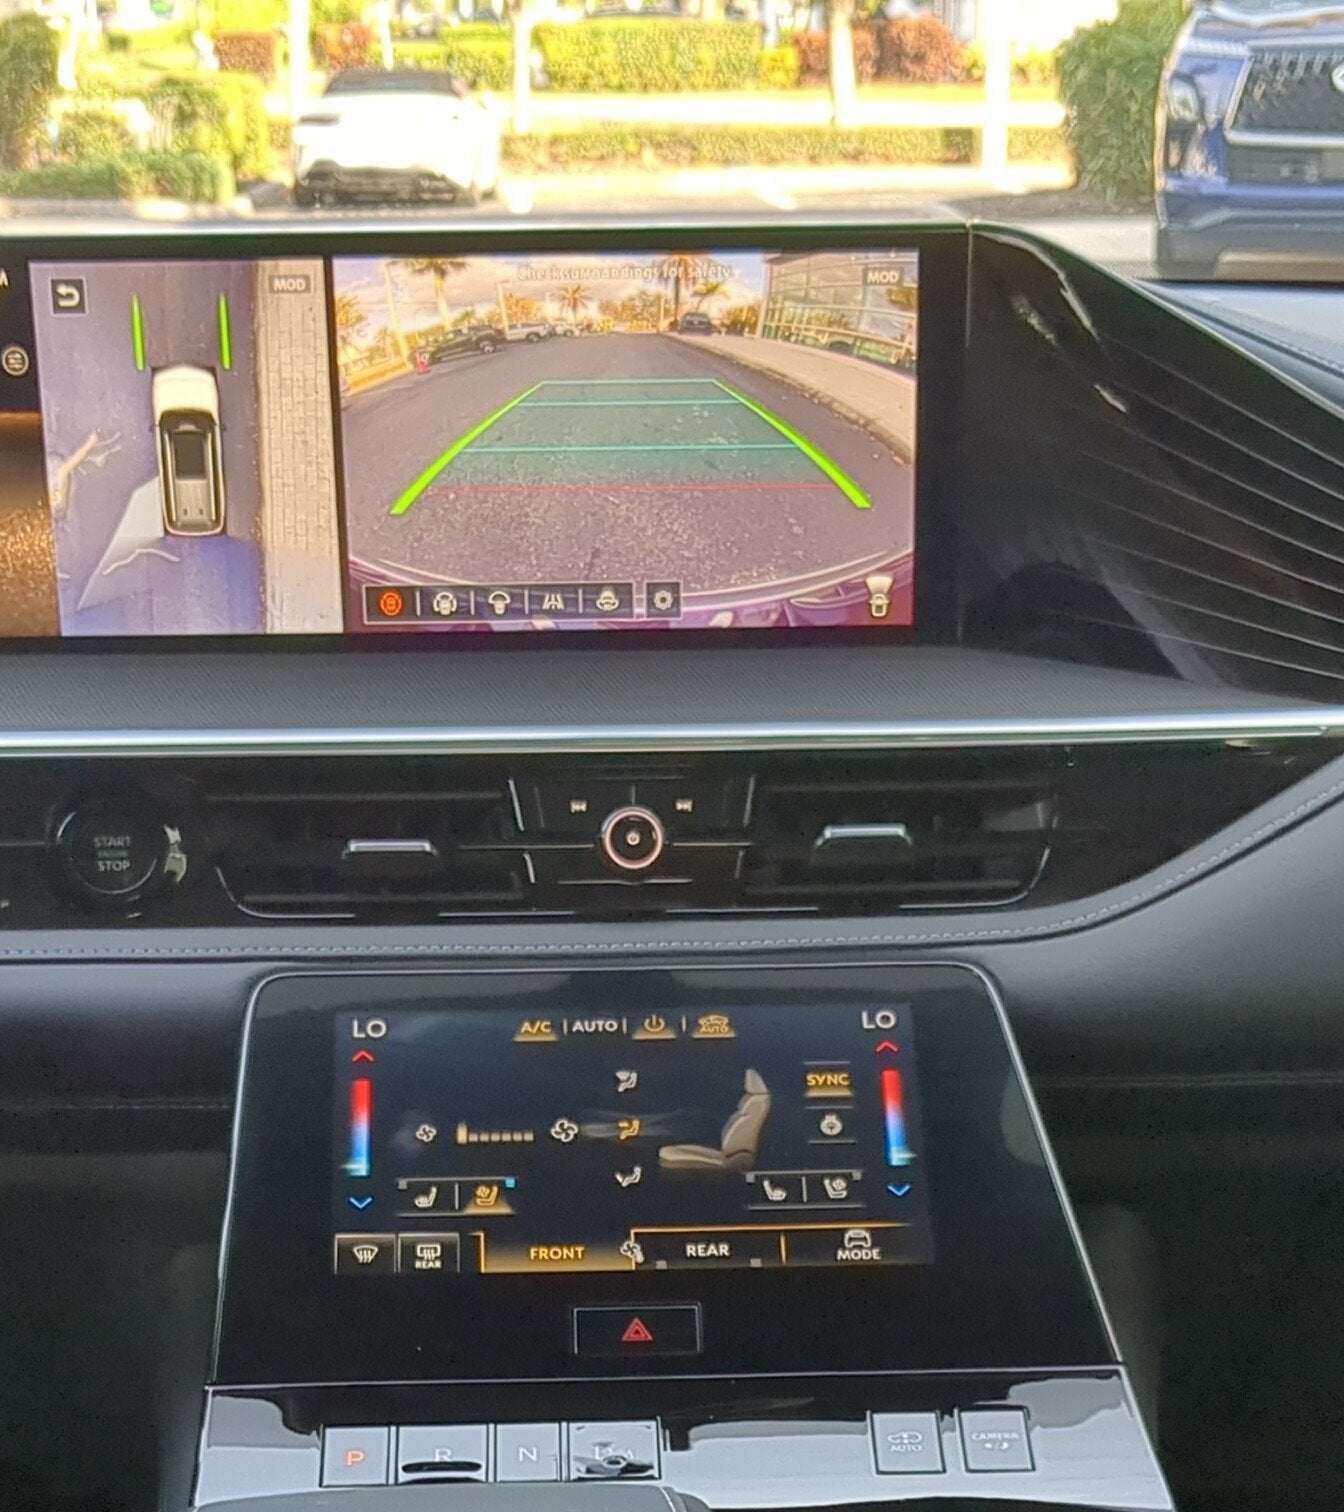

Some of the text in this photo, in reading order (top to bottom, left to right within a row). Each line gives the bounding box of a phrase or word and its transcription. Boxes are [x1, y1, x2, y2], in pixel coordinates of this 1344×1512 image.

[867, 270, 900, 284] MOD
[273, 278, 306, 292] MOD
[98, 860, 130, 872] STOP
[520, 1020, 552, 1034] A/C
[572, 1020, 619, 1033] AUTO
[861, 1010, 897, 1030] LO
[352, 1019, 388, 1039] LO
[699, 1024, 729, 1034] AUTO
[807, 1073, 851, 1087] SYNC
[530, 1246, 585, 1260] FRONT
[685, 1244, 731, 1258] REAR
[837, 1249, 882, 1260] MODE
[415, 1261, 442, 1269] REAR
[345, 1451, 364, 1466] P
[434, 1448, 453, 1462] R
[518, 1447, 538, 1462] N
